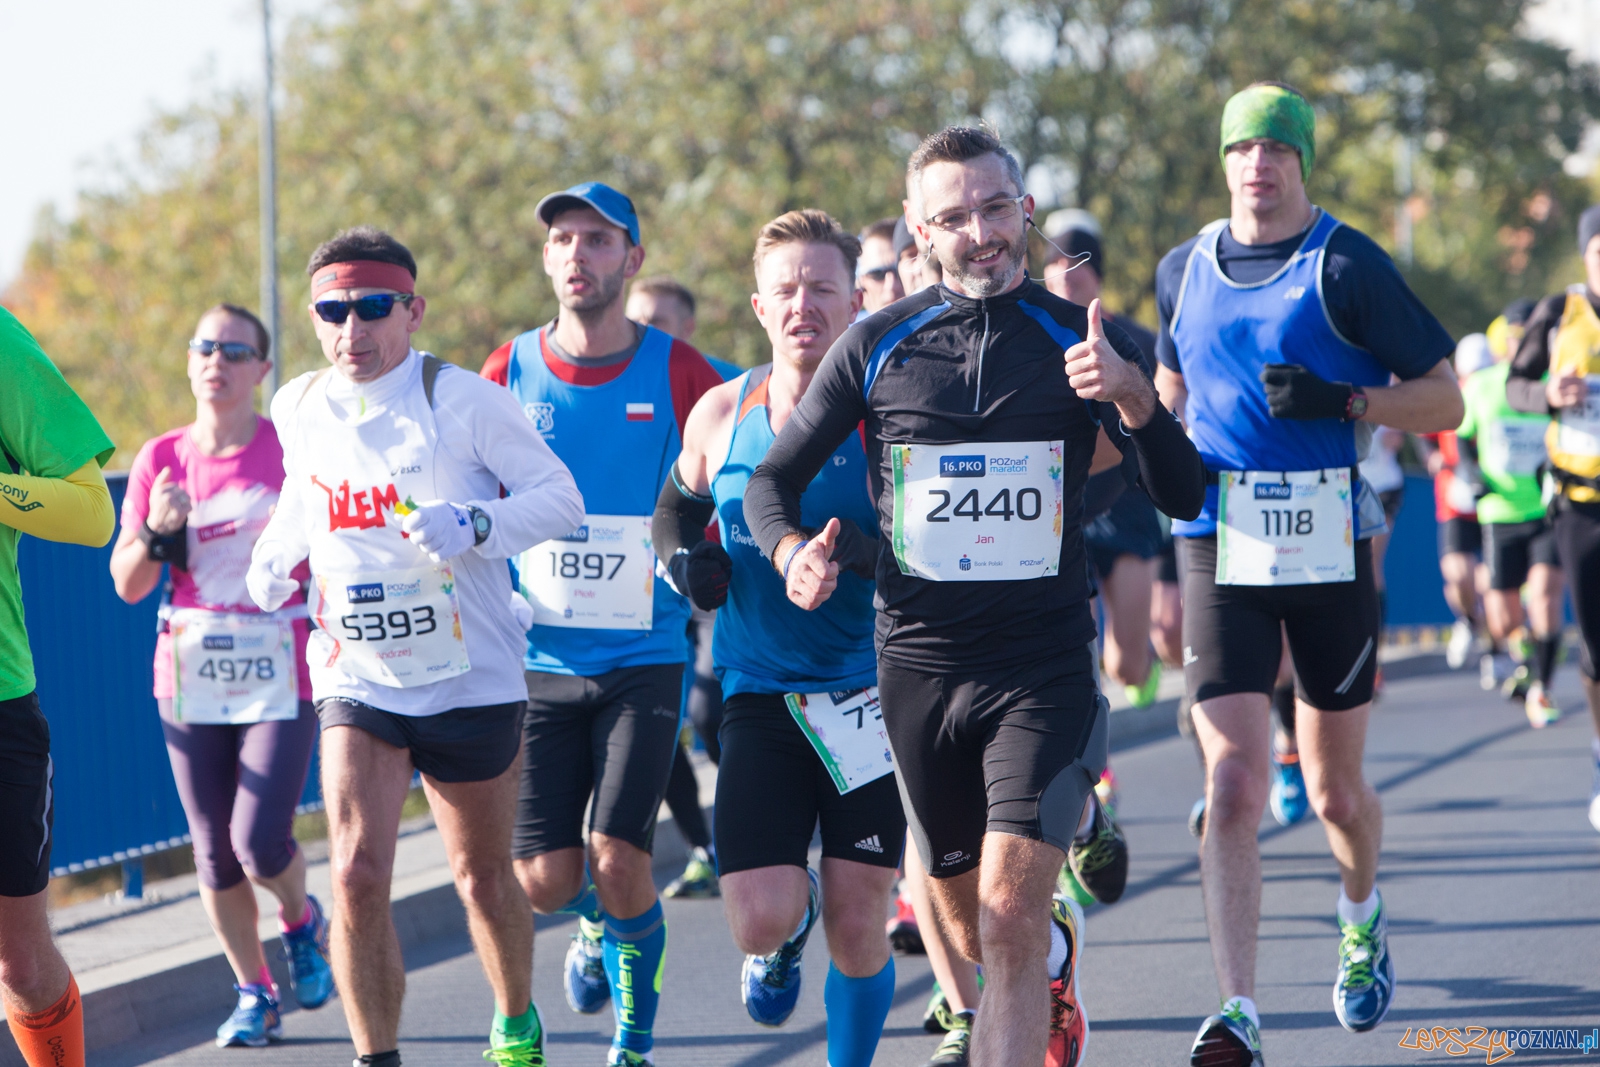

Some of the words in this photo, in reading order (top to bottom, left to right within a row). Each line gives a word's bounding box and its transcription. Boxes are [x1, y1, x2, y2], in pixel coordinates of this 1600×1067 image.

[990, 465, 1028, 473] maraton
[926, 487, 1043, 522] 2440
[1261, 509, 1313, 536] 1118
[975, 534, 995, 544] Jan
[549, 552, 626, 580] 1897
[341, 605, 437, 641] 5393
[198, 656, 275, 681] 4978
[854, 842, 884, 854] adidas
